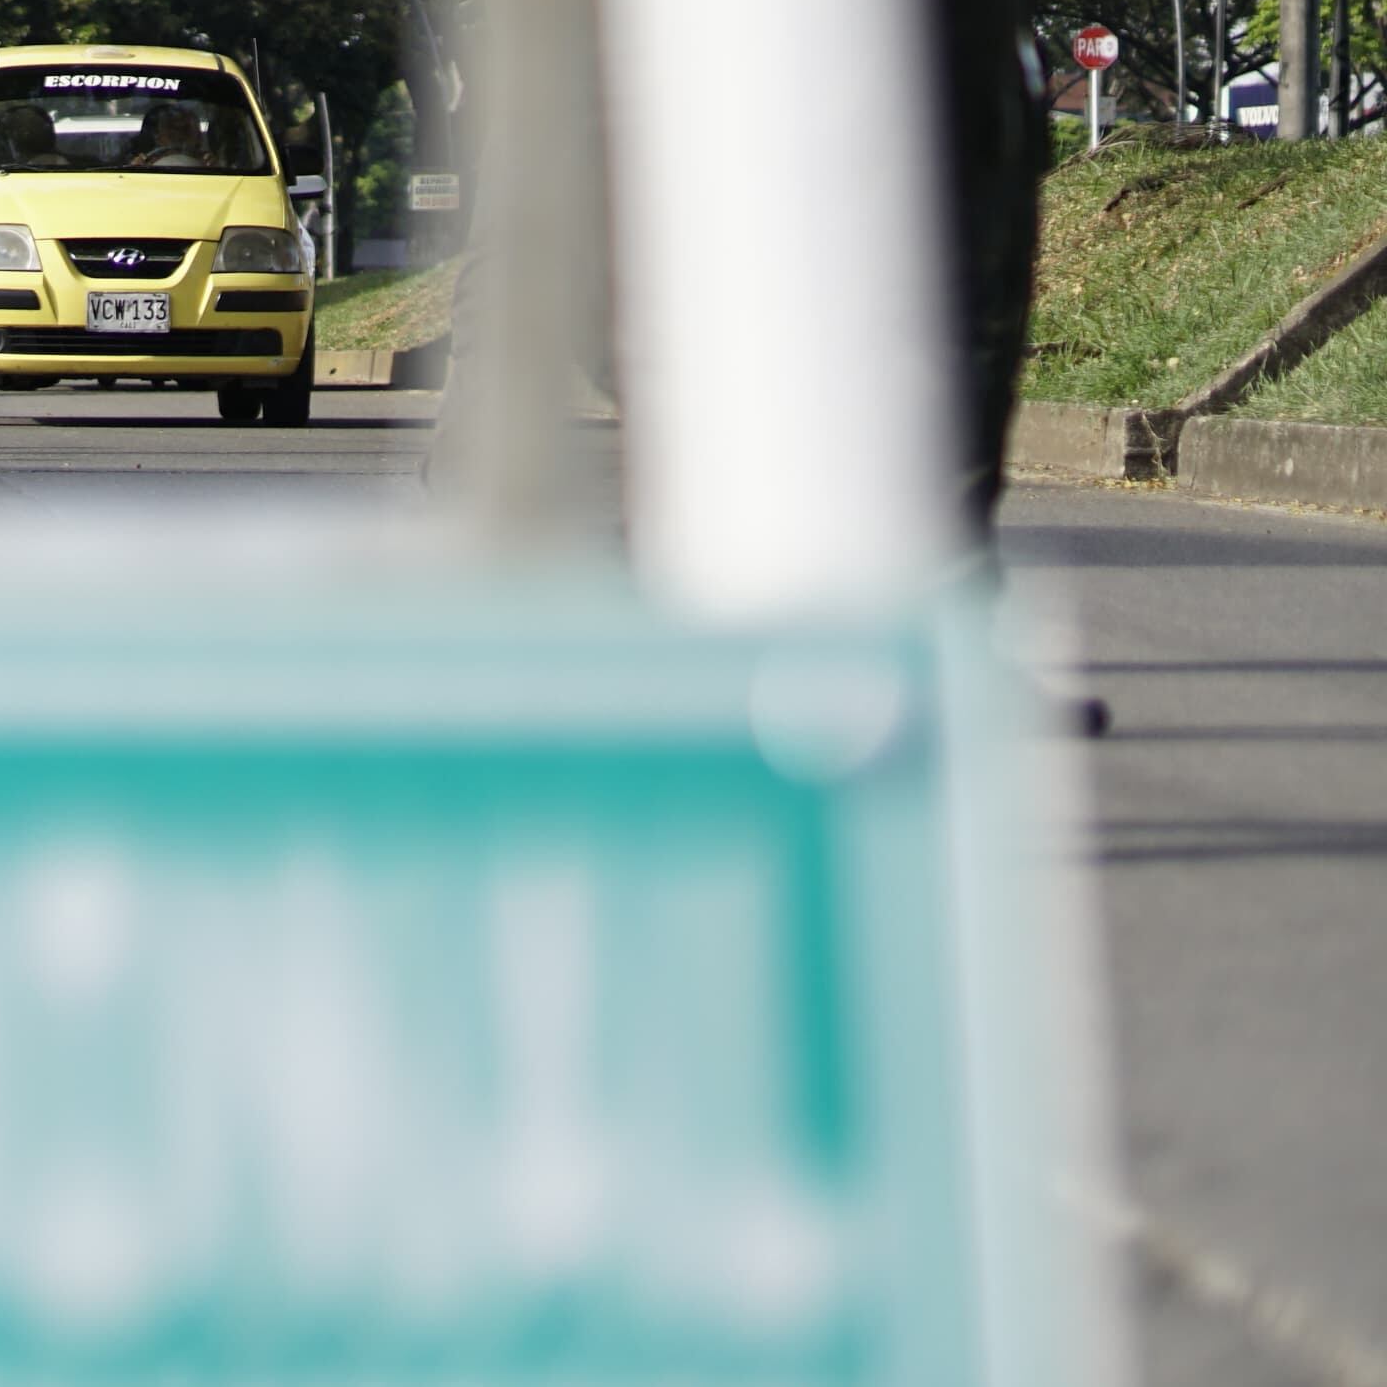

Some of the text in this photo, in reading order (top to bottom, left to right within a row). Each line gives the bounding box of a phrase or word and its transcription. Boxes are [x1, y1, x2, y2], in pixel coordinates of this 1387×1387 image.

[44, 75, 180, 90] ESCORPION
[91, 299, 167, 320] VCW 133
